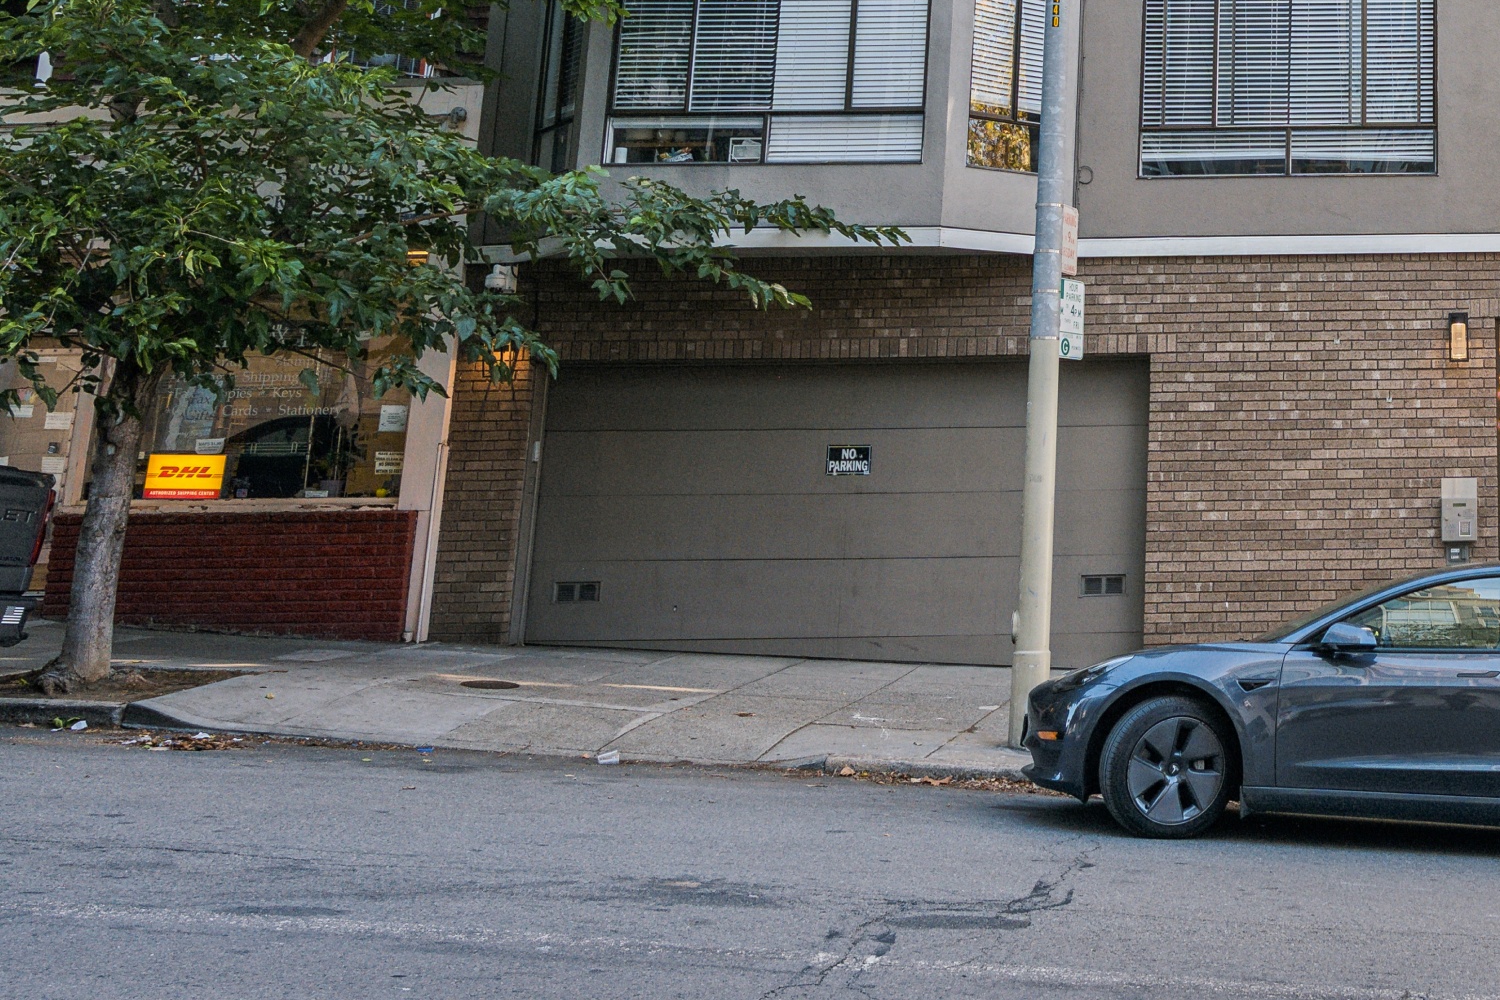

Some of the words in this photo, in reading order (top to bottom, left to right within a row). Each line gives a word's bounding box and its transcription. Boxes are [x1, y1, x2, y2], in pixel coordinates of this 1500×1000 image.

[1066, 292, 1082, 303] PARKING
[243, 371, 299, 389] Shipping
[272, 386, 302, 401] Keys
[222, 404, 258, 416] Cards
[278, 404, 340, 418] Stationery
[841, 448, 856, 460] NO
[158, 466, 213, 478] DHL
[829, 460, 868, 472] PARKING
